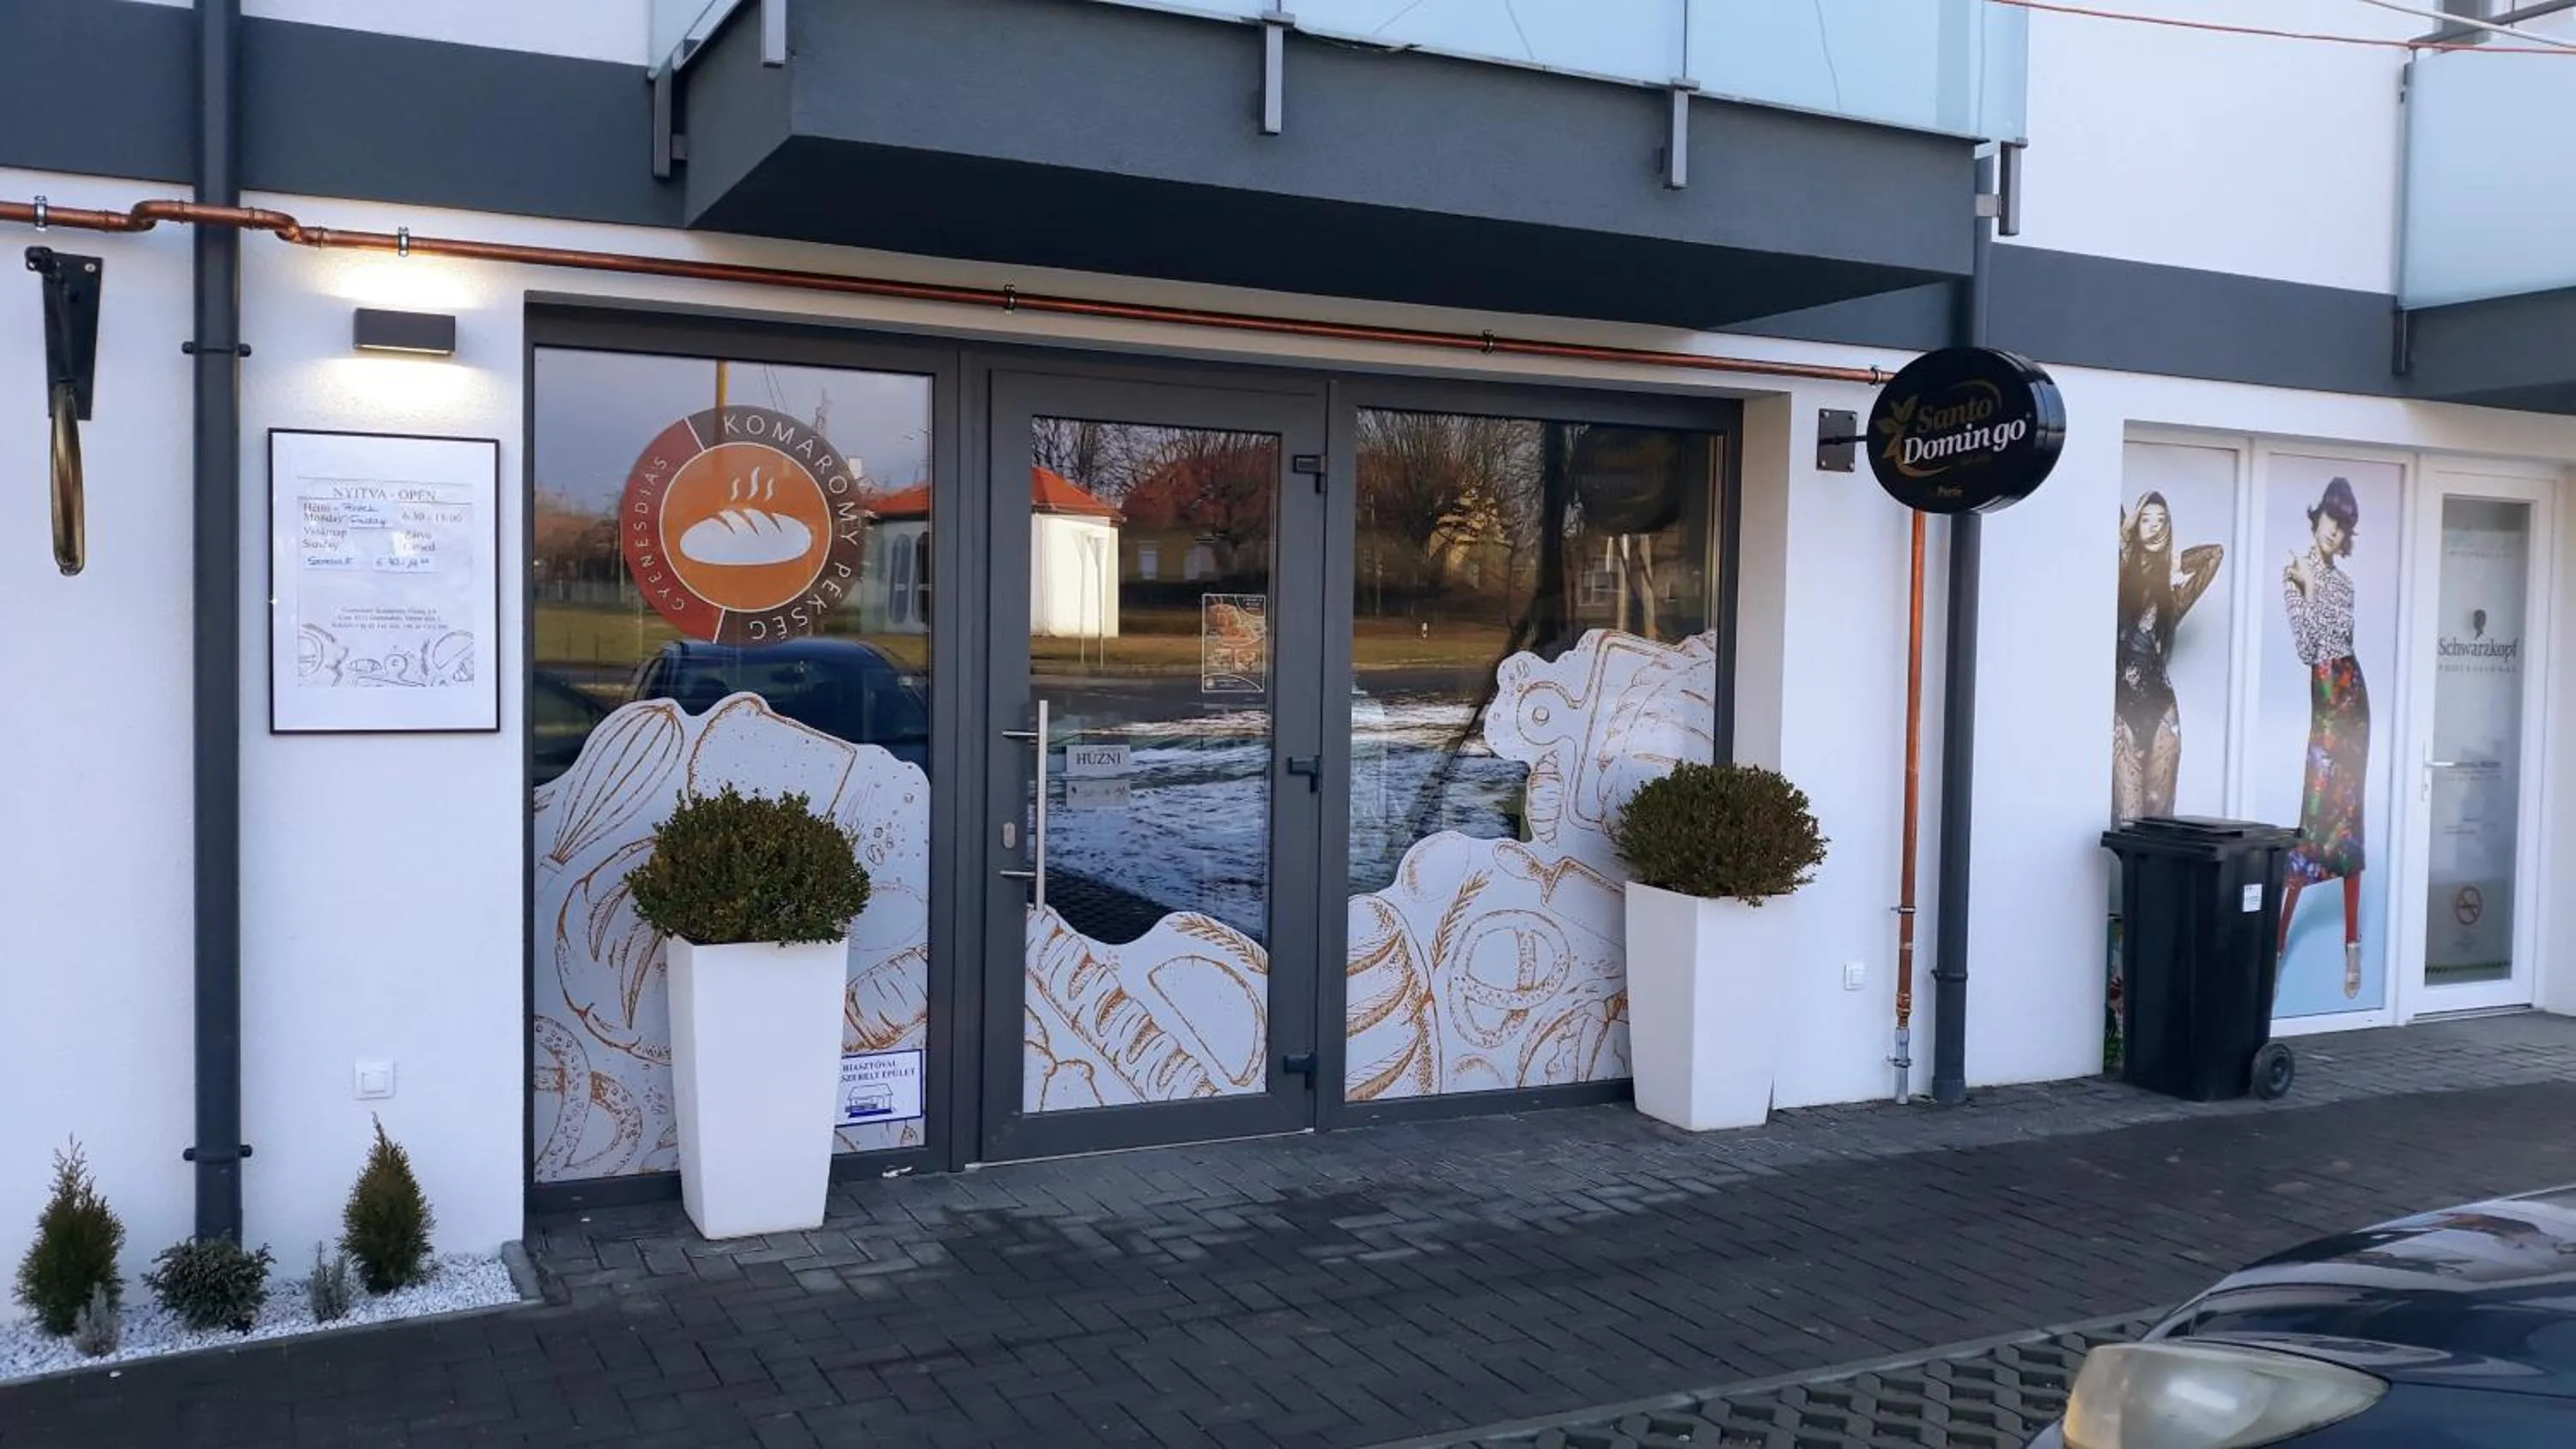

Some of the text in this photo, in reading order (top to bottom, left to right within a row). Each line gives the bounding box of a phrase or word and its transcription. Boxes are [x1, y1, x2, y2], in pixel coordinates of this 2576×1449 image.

[1917, 395, 1993, 433] Santo
[1902, 418, 2027, 465] Domingo
[333, 486, 386, 500] NYITVA
[398, 489, 437, 501] OPEN
[723, 414, 858, 640] KOMÁROMY PÉKSÉG
[2438, 637, 2519, 663] Schwarzkopf
